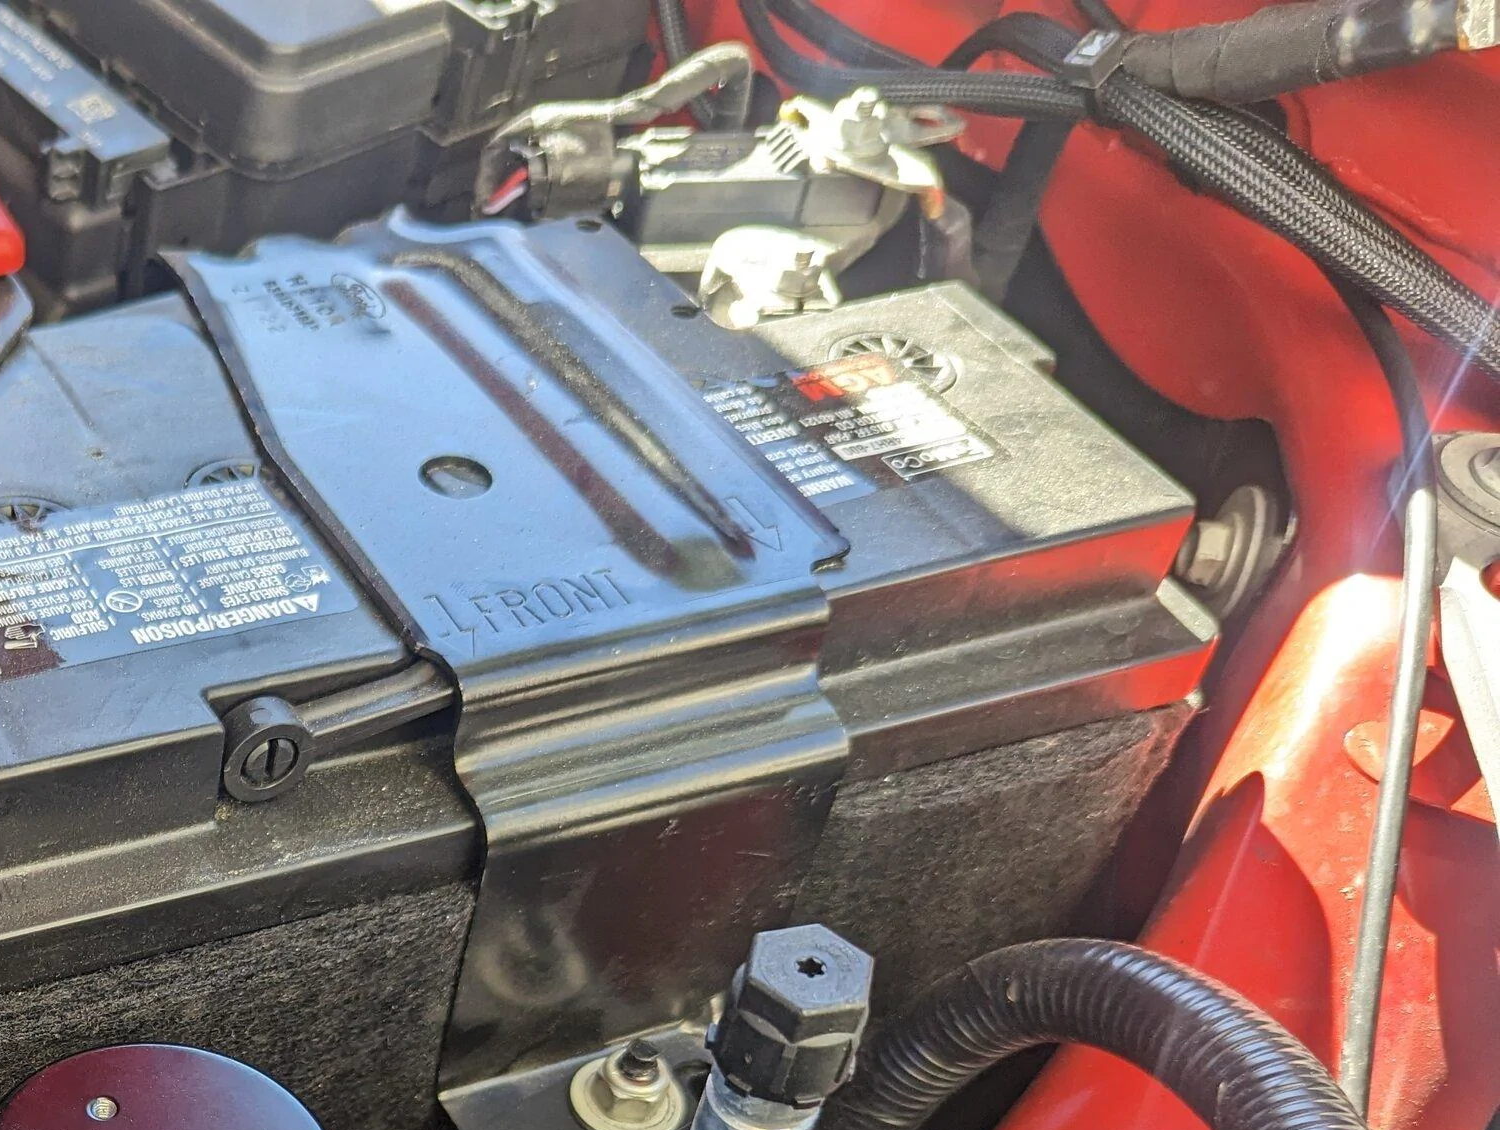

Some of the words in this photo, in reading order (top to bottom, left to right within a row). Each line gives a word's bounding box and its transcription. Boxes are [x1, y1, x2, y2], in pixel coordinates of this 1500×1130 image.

[821, 430, 853, 444] PAR
[220, 485, 242, 496] PAS
[243, 482, 257, 492] NE
[165, 496, 181, 506] LA
[181, 489, 220, 502] OUVRIR
[233, 492, 263, 504] TENIR
[188, 502, 203, 512] DE
[204, 497, 233, 509] HORS
[248, 501, 271, 512] KEEP
[172, 505, 188, 515] LA
[191, 511, 211, 521] THE
[213, 509, 226, 518] OF
[226, 505, 247, 516] OUT
[110, 516, 133, 528] DES
[145, 522, 158, 532] OF
[157, 516, 191, 529] REACH
[44, 529, 59, 540] NE
[271, 525, 292, 537] GAZ
[20, 533, 43, 544] PAS
[53, 537, 74, 549] NOT
[75, 534, 90, 544] DO
[15, 546, 31, 556] DO
[107, 543, 140, 556] FUMER
[138, 540, 153, 550] DE
[228, 543, 248, 556] LES
[141, 550, 160, 561] LES
[179, 553, 200, 567] LES
[199, 548, 229, 562] YEUX
[255, 548, 308, 564] BLINDNESS
[45, 556, 65, 567] DES
[204, 560, 239, 574] INJURY
[239, 557, 255, 567] OR
[49, 566, 71, 578] PEUT
[229, 569, 250, 581] CAN
[250, 563, 286, 578] GASES
[1, 577, 16, 586] LA
[15, 570, 48, 585] CAUSER
[119, 576, 138, 588] LES
[197, 573, 230, 588] CAUSE
[140, 583, 183, 599] SMOKING
[221, 576, 281, 595] EXPLOSIVE
[69, 589, 86, 600] OR
[250, 585, 289, 601] SHIELD
[28, 593, 69, 608] SEVERE
[71, 599, 93, 611] CAN
[220, 593, 250, 607] EYES
[469, 567, 635, 633] FRONT
[37, 604, 71, 618] CAUSE
[181, 603, 199, 615] NO
[71, 609, 100, 624] ACID
[132, 600, 296, 642] DANGER/POISON
[50, 620, 108, 640] SULFURIC
